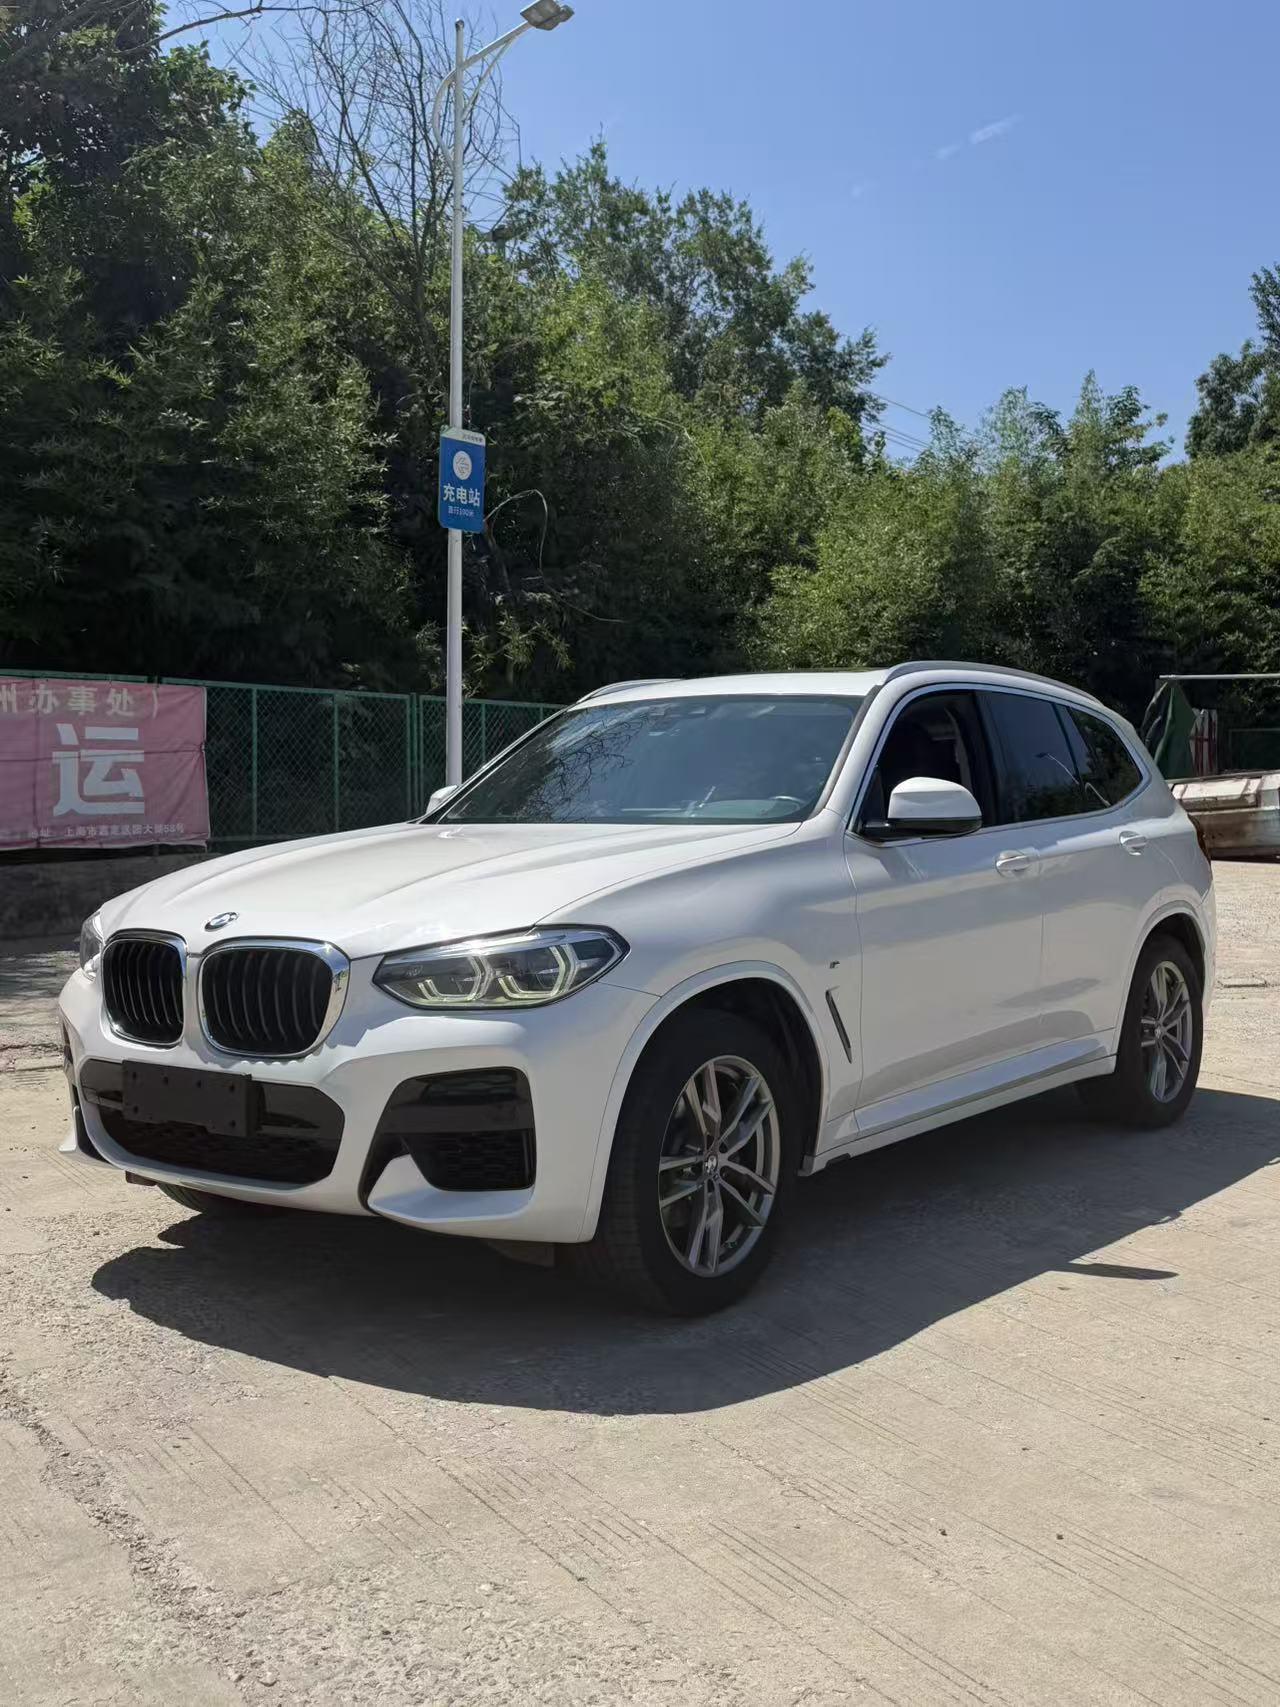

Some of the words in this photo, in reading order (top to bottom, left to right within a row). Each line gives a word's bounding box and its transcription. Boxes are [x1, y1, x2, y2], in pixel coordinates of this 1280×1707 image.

[443, 482, 480, 506] 充电站
[52, 723, 145, 816] 运
